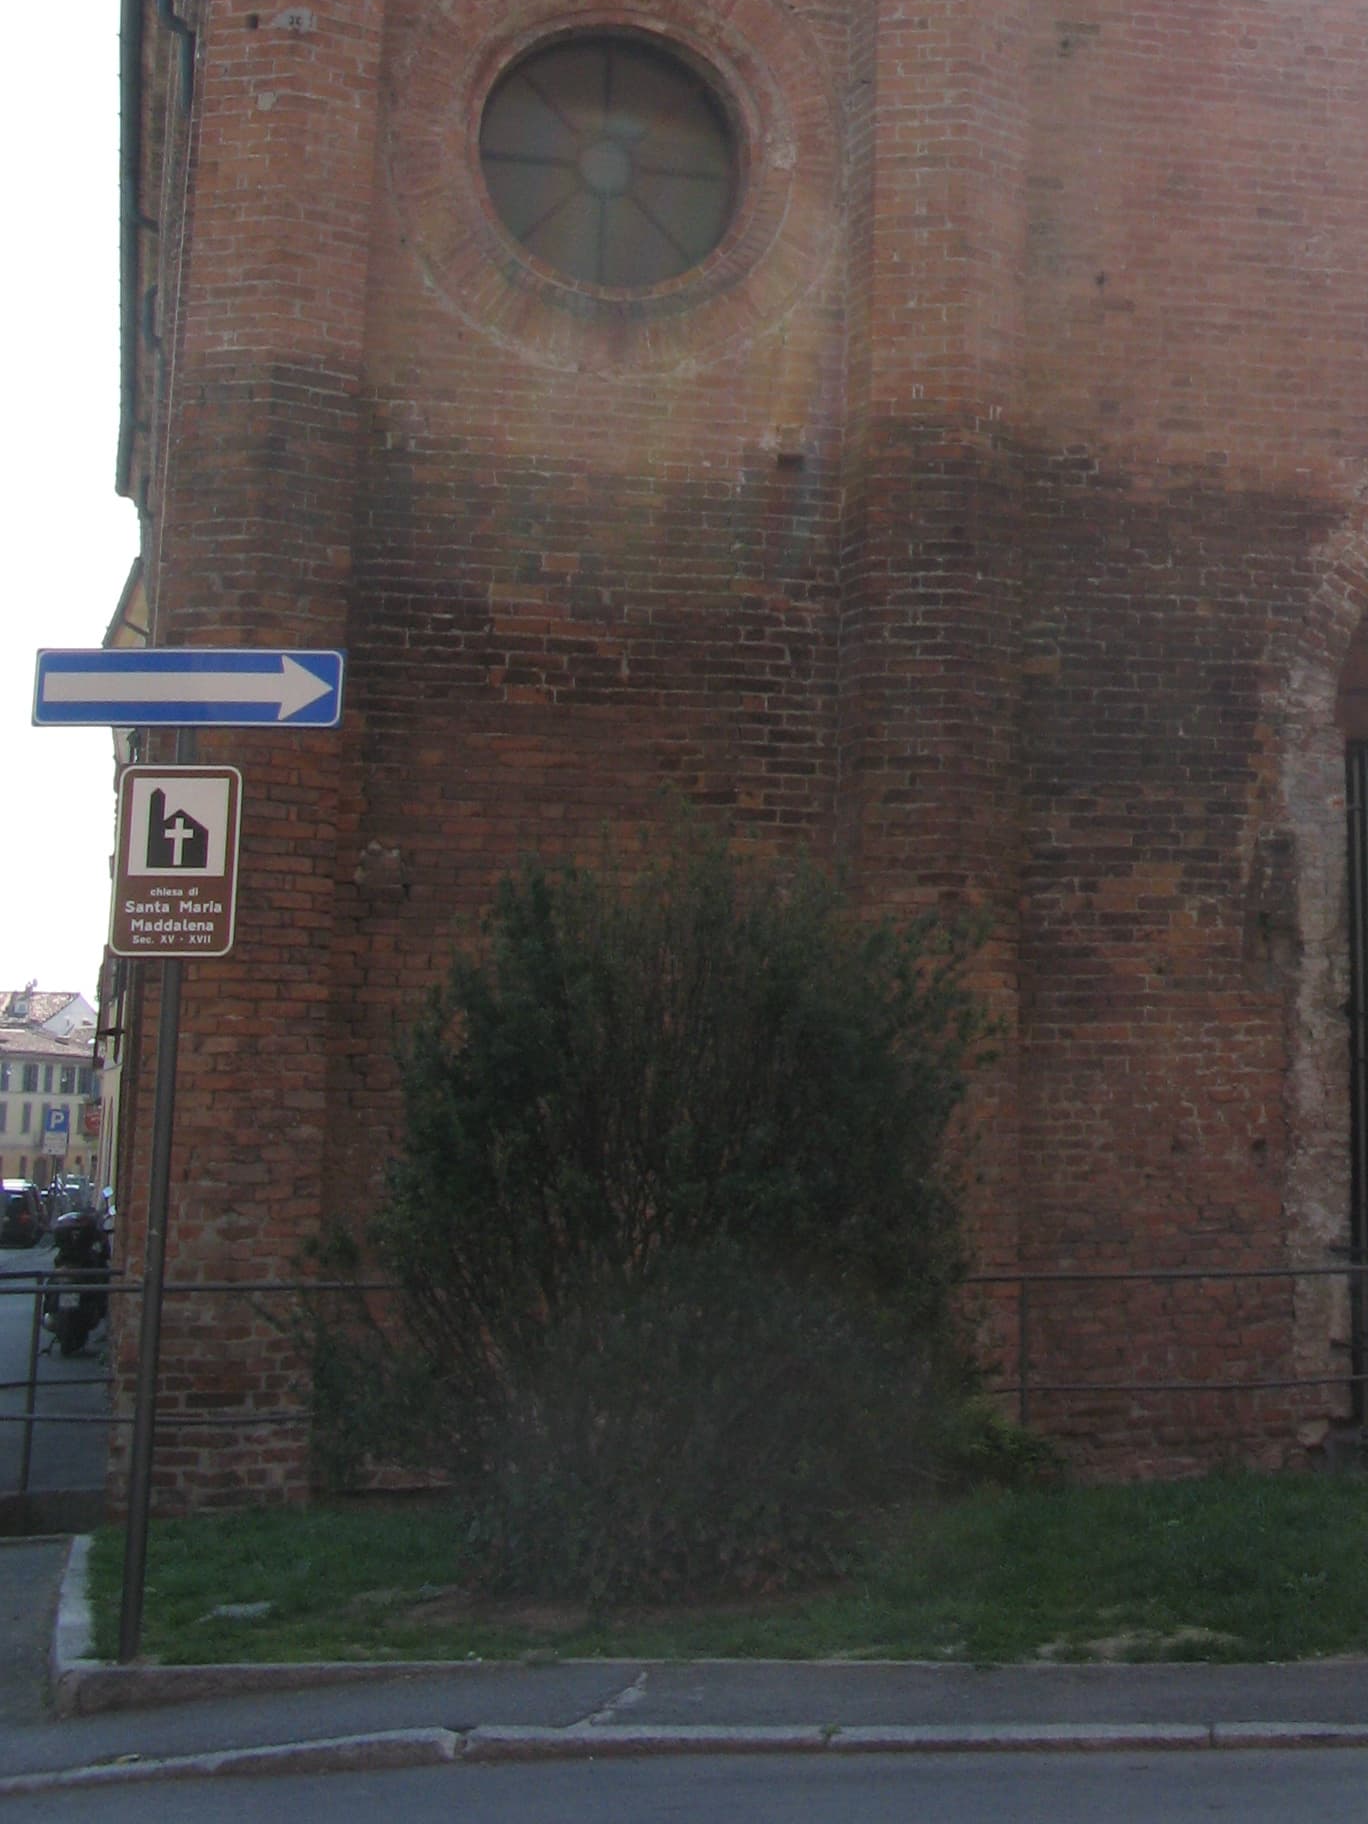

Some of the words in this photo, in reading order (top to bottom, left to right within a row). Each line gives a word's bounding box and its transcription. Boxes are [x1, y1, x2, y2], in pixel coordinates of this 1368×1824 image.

[150, 887, 183, 896] chiesa
[188, 887, 199, 896] di
[125, 900, 170, 913] Santa
[179, 900, 222, 913] Maria
[131, 919, 214, 932] Maddalena
[132, 935, 155, 944] Sec.
[160, 935, 175, 944] XV
[189, 935, 211, 944] XVII
[50, 1111, 65, 1129] P
